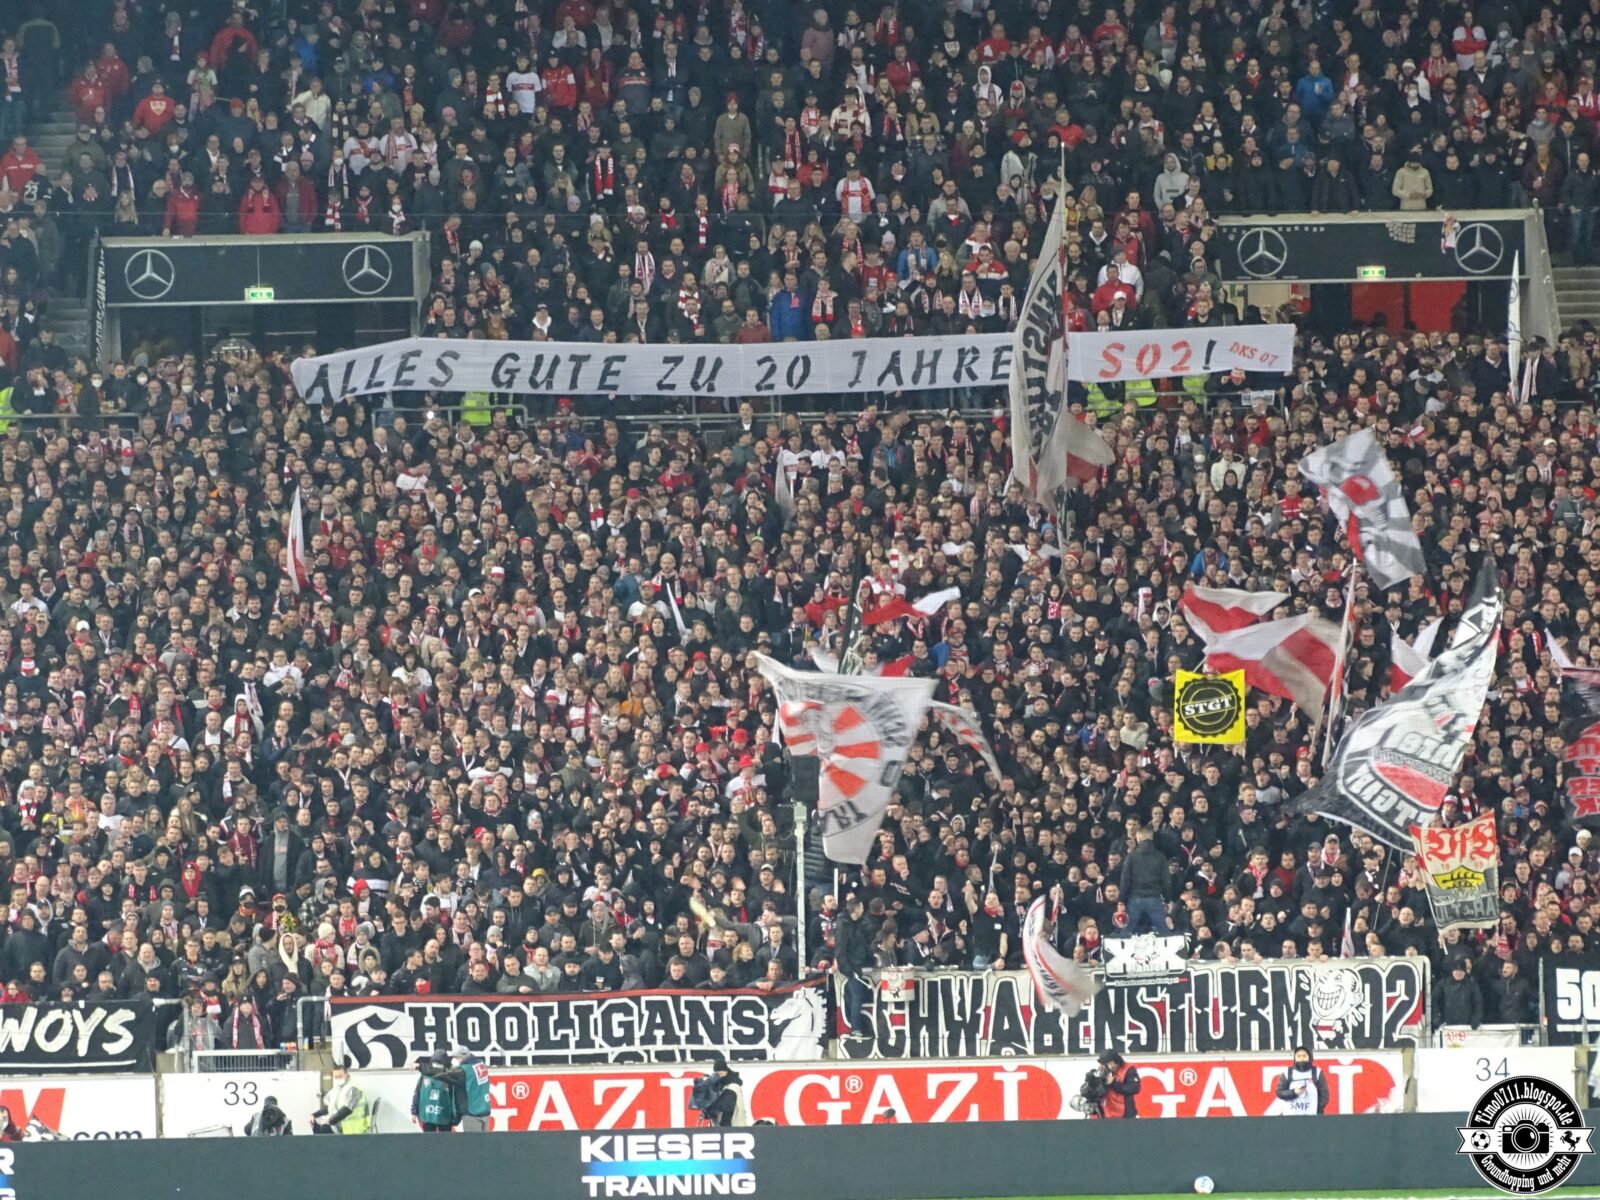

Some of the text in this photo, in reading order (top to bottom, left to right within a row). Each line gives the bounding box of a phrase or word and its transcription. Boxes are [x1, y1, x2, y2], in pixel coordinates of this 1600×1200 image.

[304, 349, 461, 400] ALLES
[490, 352, 628, 391] GUTE
[656, 354, 724, 392] ZU
[754, 354, 812, 392] 20
[848, 344, 1013, 389] JAHRE
[1228, 340, 1258, 361] DKS
[1184, 696, 1232, 716] STGT
[405, 996, 769, 1053] HOOLIGANS
[1475, 1057, 1511, 1081] 34
[224, 1081, 259, 1106] 33
[581, 1132, 755, 1163] KIESER
[582, 1172, 756, 1198] TRAINING
